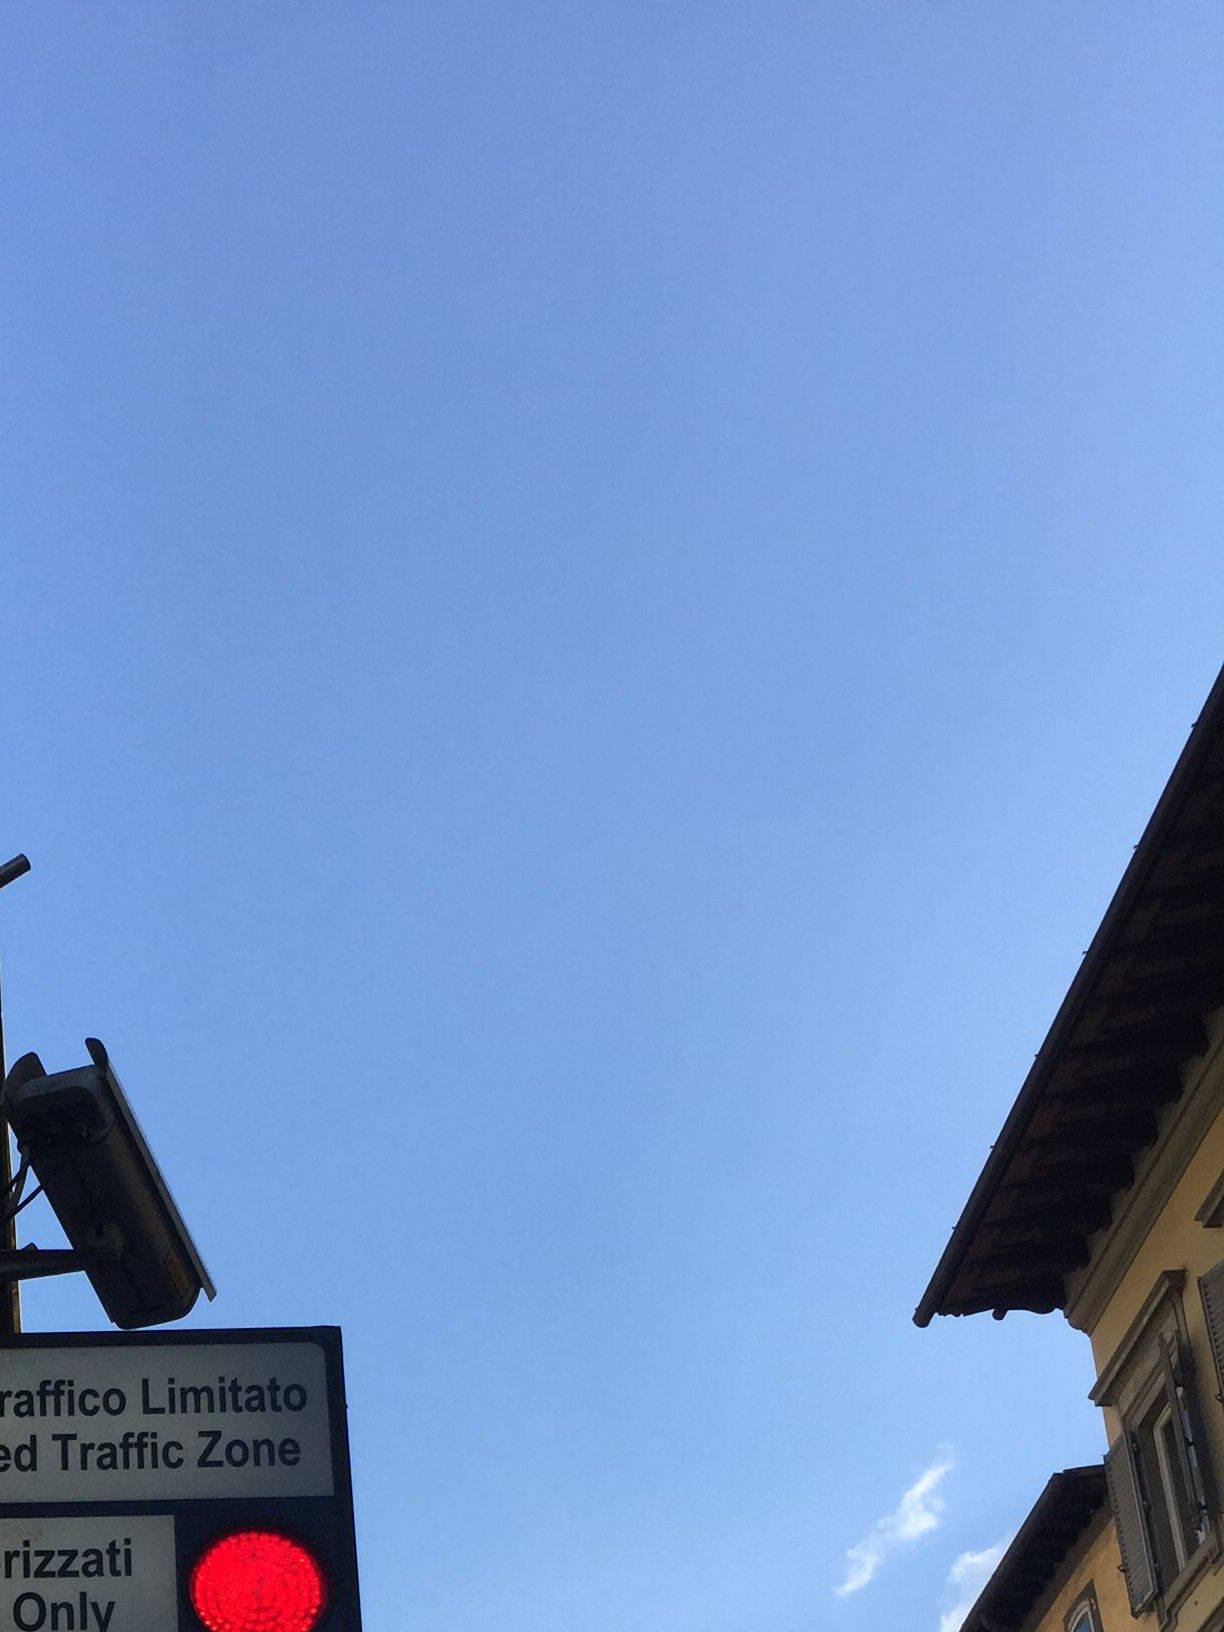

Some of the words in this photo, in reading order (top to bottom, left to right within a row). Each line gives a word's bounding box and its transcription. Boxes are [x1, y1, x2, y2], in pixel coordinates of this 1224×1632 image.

[142, 1376, 308, 1415] Limitato
[52, 1431, 184, 1471] Traffic
[197, 1430, 301, 1468] Zone
